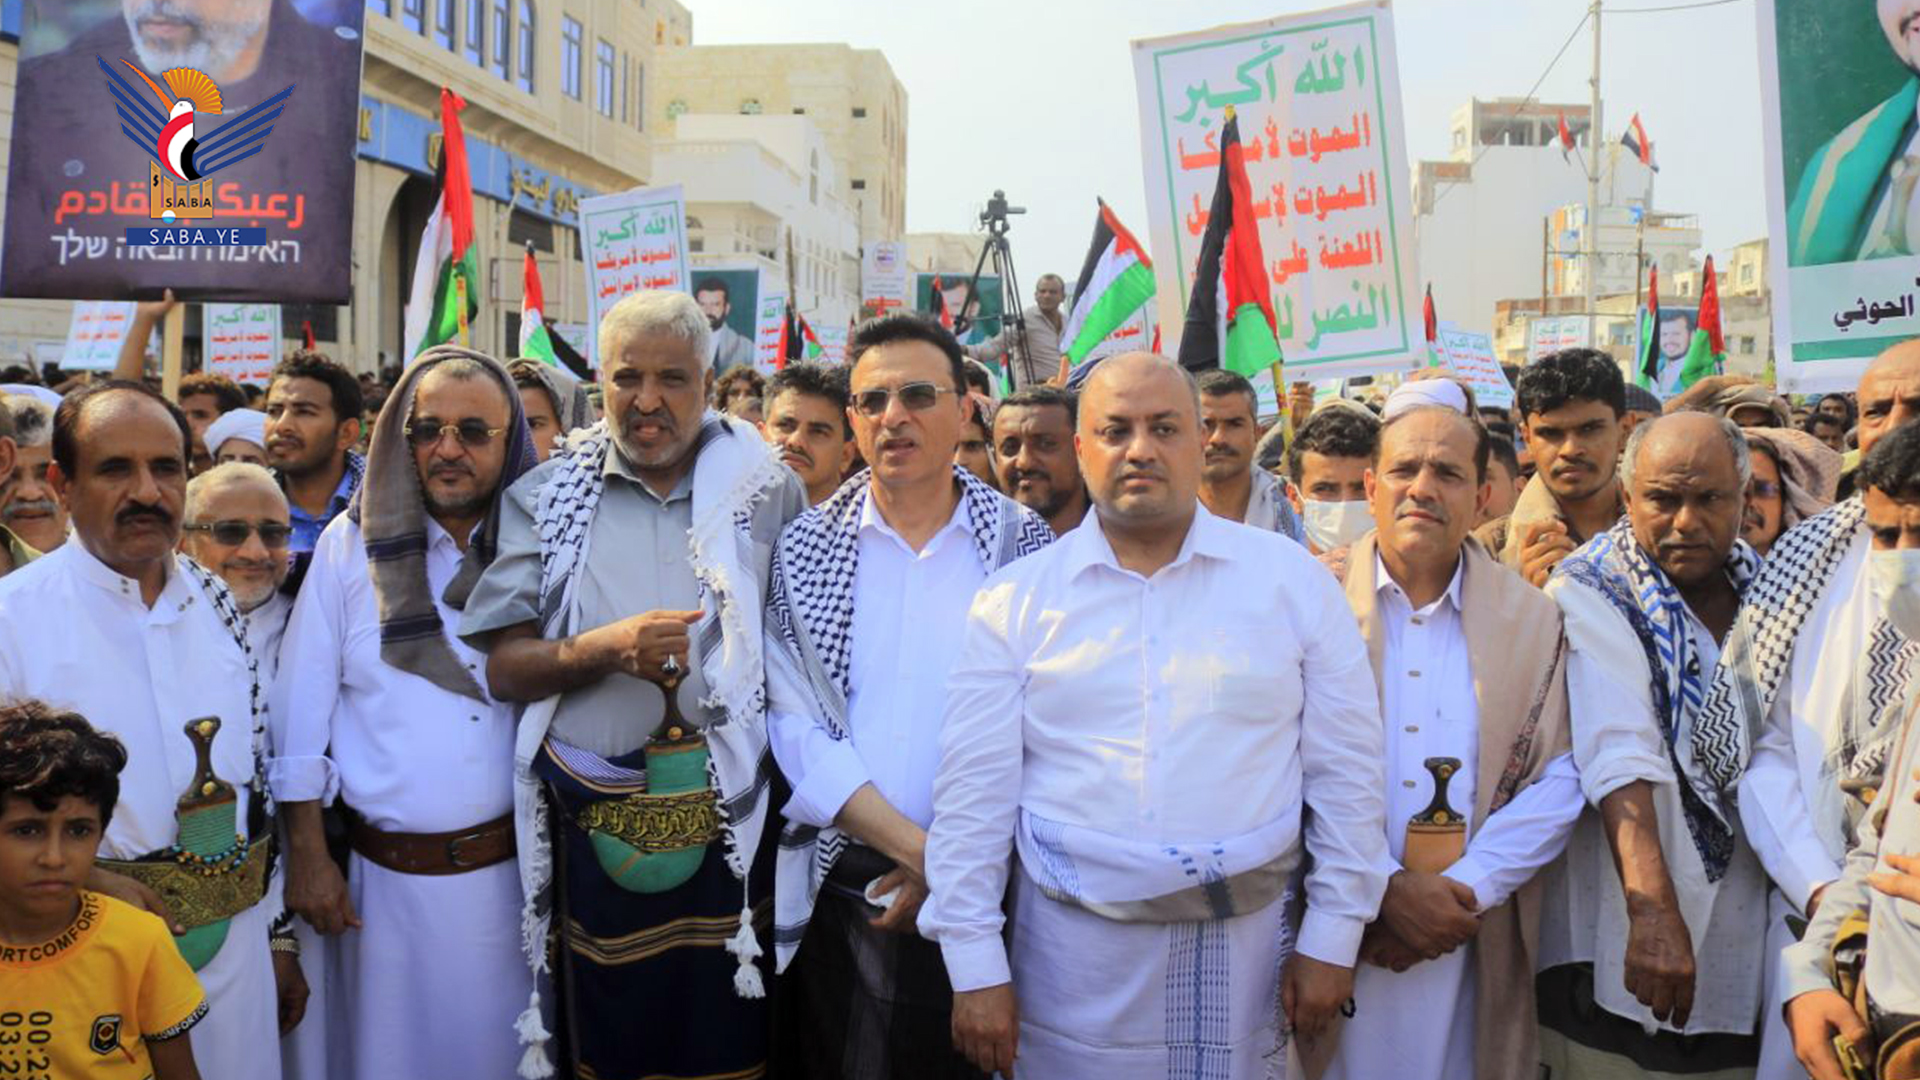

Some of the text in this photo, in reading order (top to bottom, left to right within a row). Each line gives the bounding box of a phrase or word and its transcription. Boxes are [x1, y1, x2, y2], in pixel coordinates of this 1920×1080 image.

[1174, 40, 1284, 127] أكبر
[1177, 112, 1370, 170] الموت لأمكا
[1294, 170, 1376, 221] الموت
[51, 228, 107, 265] שלך
[1273, 228, 1382, 284] اللعنة على
[1305, 280, 1390, 350] النصر
[1834, 294, 1914, 332] الحوثي
